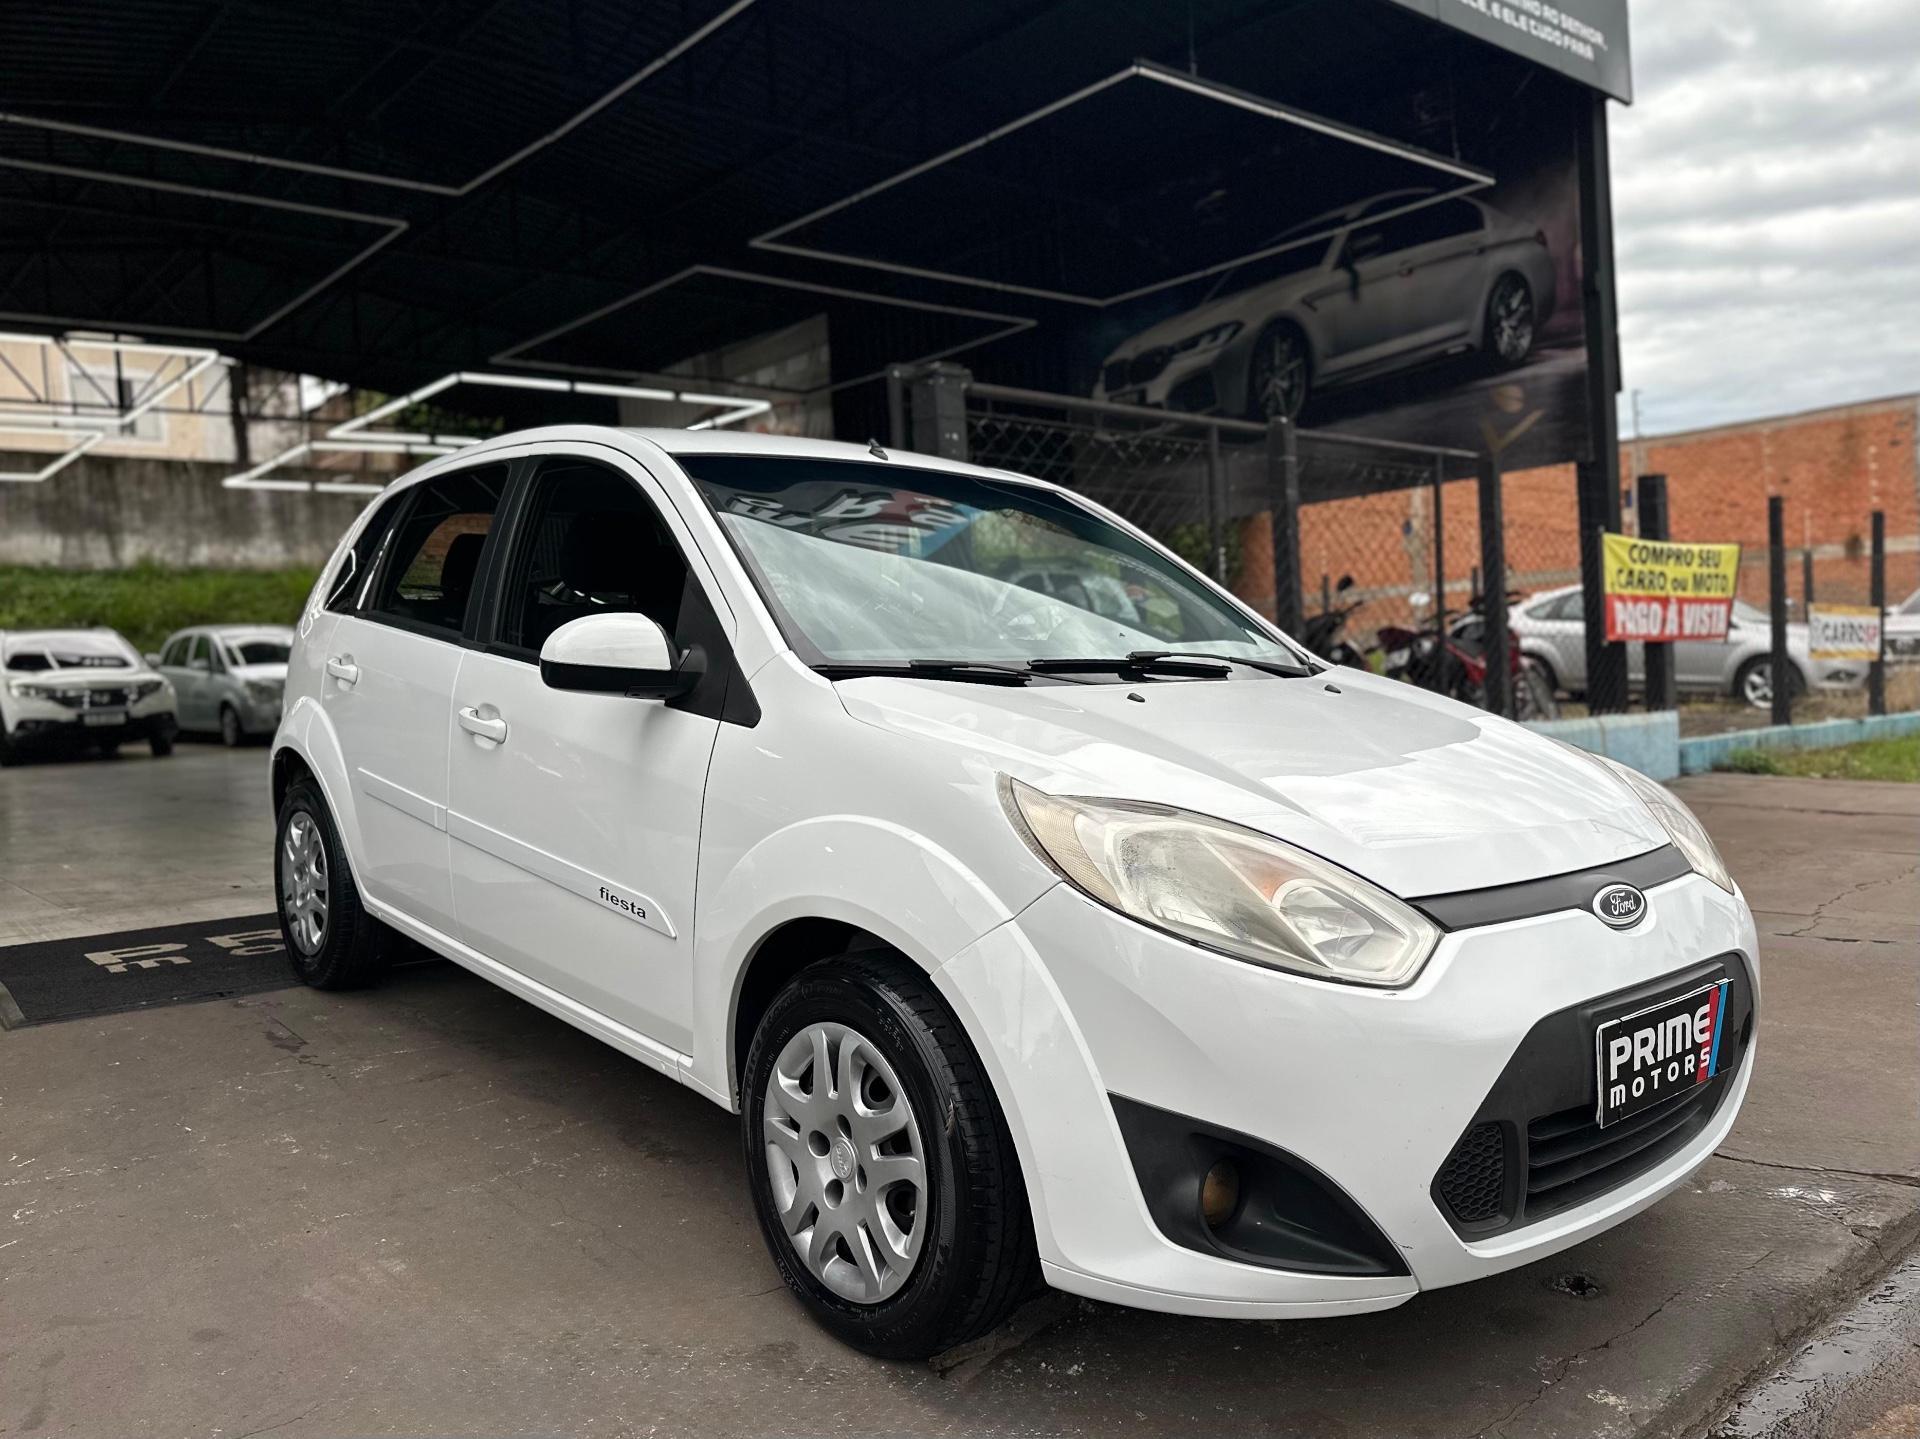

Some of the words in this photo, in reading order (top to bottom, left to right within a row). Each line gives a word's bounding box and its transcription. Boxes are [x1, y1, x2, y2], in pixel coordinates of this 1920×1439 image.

[1629, 544, 1694, 567] COMPRO
[1698, 548, 1722, 568] SEU
[1616, 567, 1667, 592] CARRO
[1671, 577, 1688, 592] ou
[1692, 573, 1729, 593] MOTO
[1613, 600, 1663, 636] PAGO
[1682, 602, 1728, 636] VISTA
[599, 886, 646, 919] fiesta
[1610, 891, 1636, 915] Ford
[1609, 1003, 1711, 1081] PRIME
[1609, 1046, 1711, 1109] MOTORS
